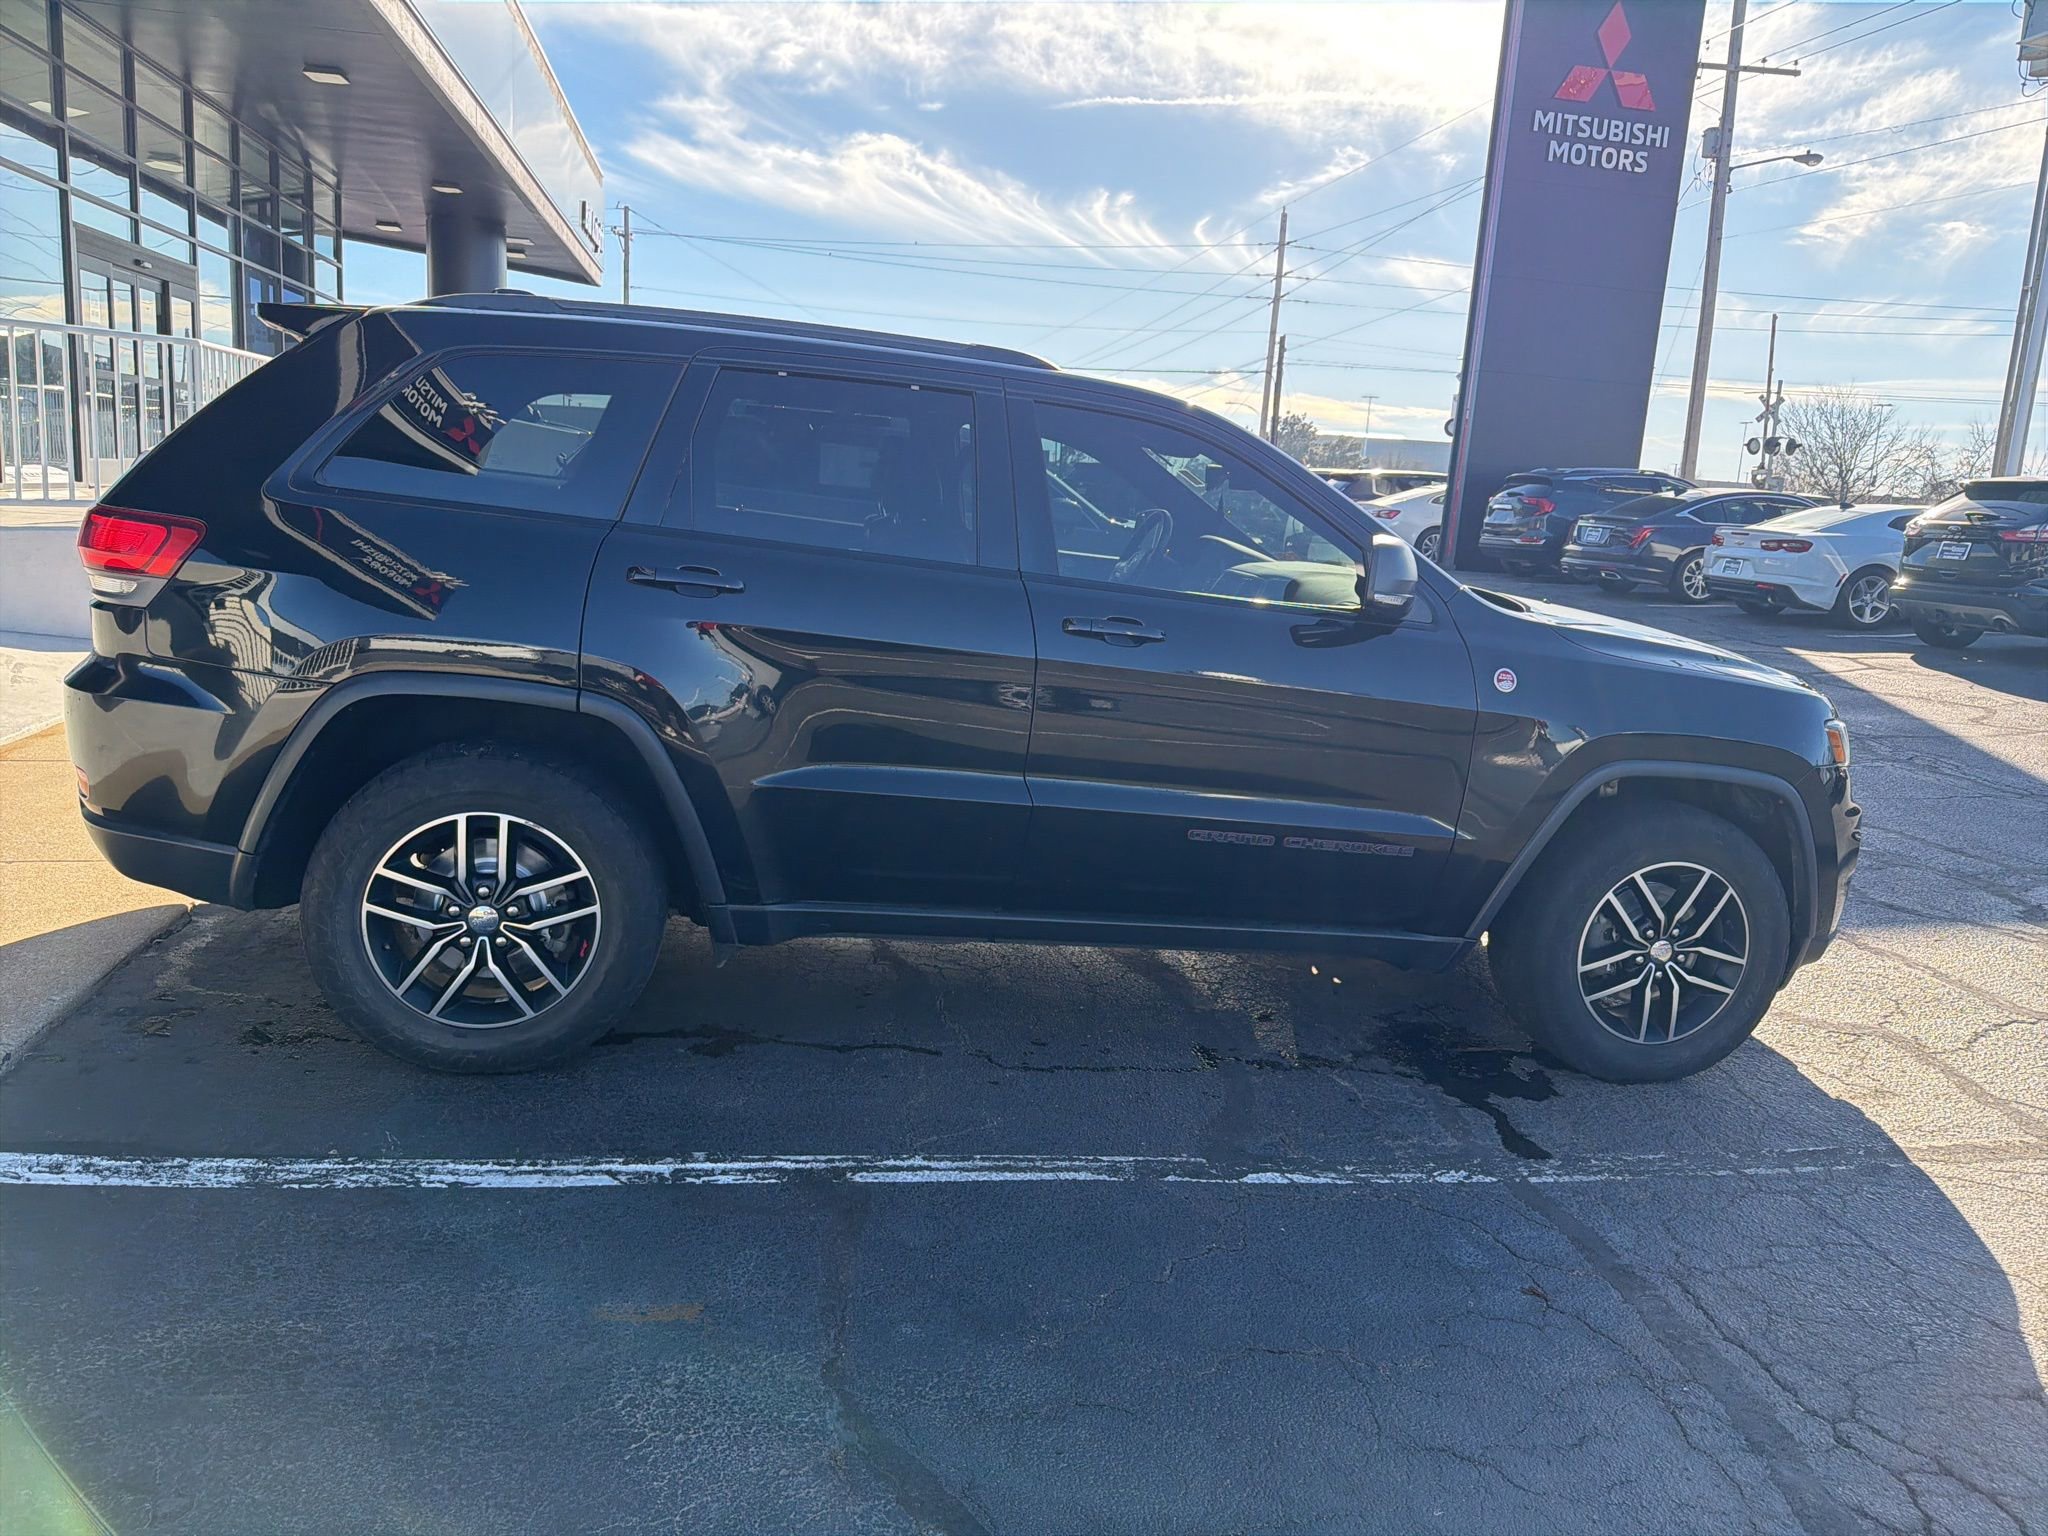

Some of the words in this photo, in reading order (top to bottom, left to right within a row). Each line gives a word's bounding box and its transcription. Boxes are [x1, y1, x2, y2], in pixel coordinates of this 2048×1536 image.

[1533, 110, 1670, 148] MITSUBISHI
[1547, 140, 1648, 173] MOTORS
[1187, 829, 1275, 846] GRAND
[1283, 836, 1415, 857] CHEROKEE
